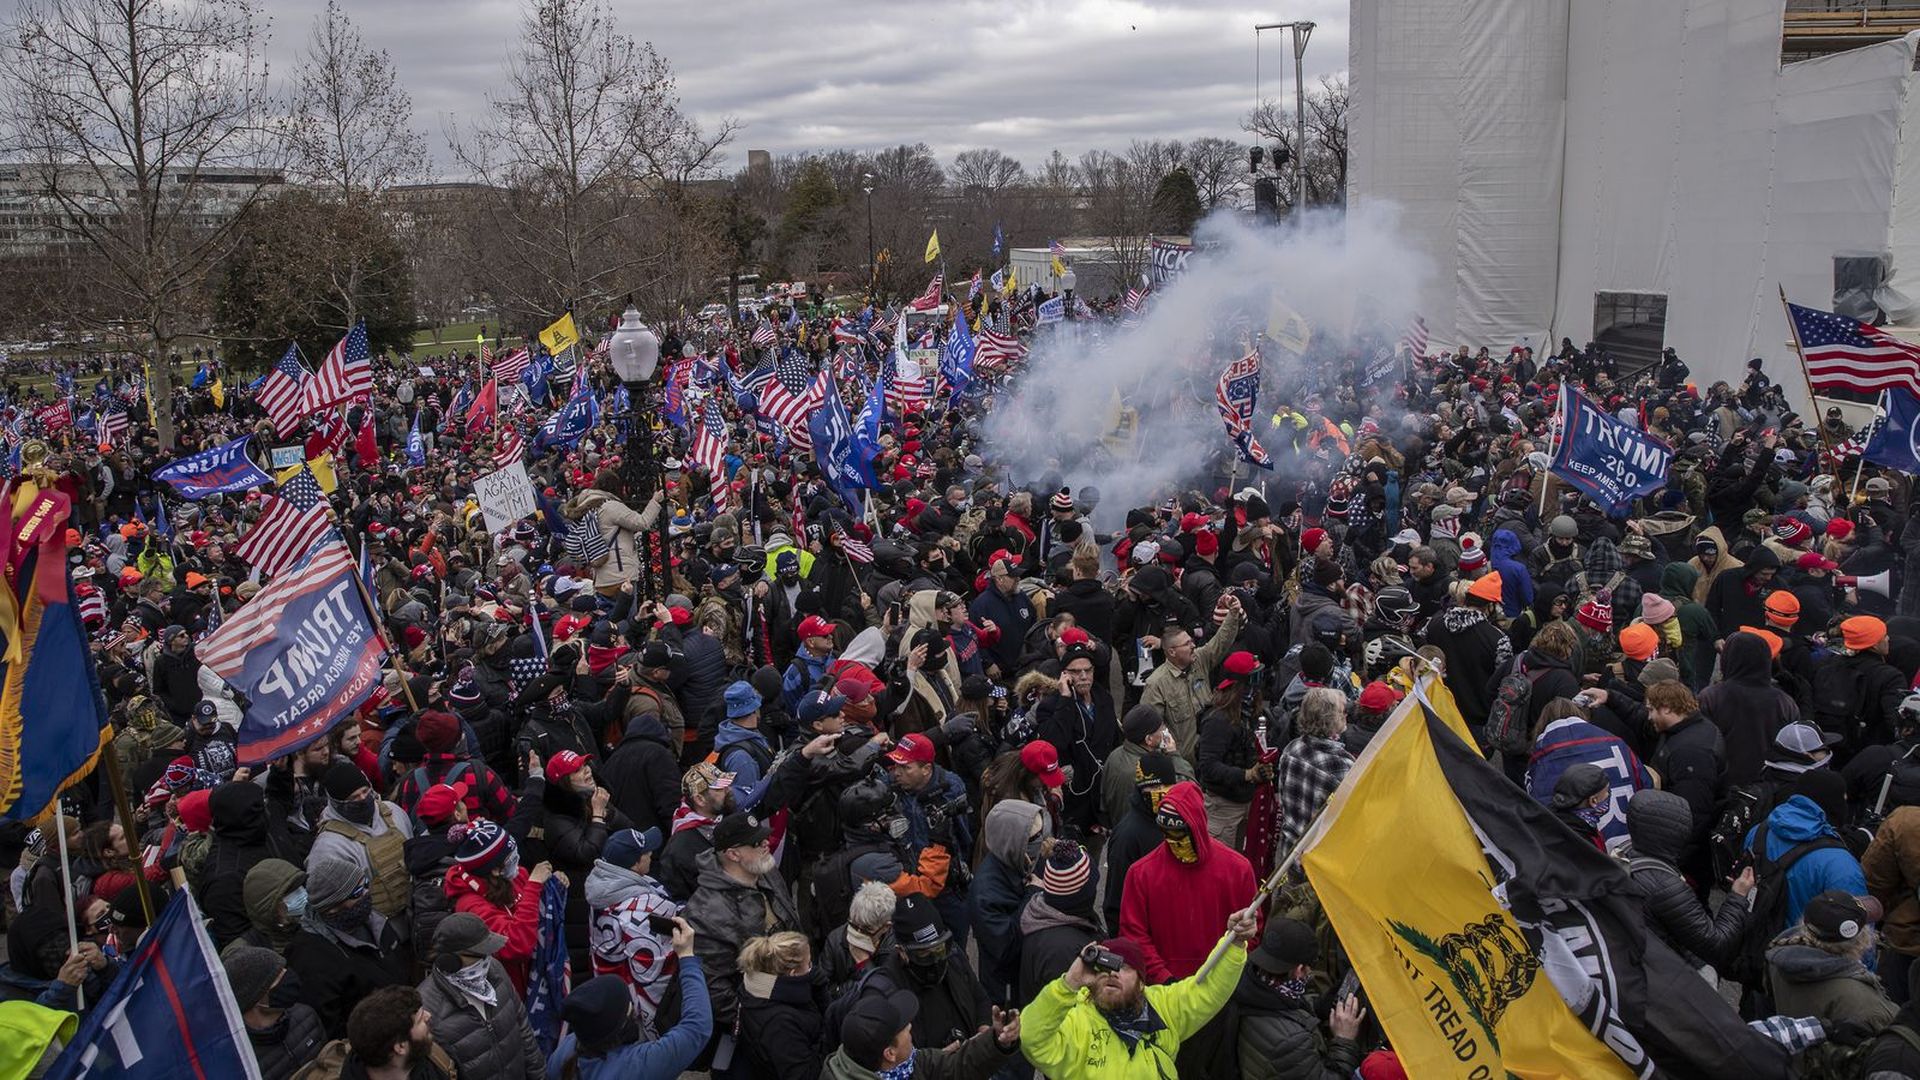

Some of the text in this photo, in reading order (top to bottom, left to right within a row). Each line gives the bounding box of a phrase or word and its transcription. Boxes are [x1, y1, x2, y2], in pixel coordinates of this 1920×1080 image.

[1568, 459, 1596, 476] KEEP
[483, 474, 521, 502] AGAIN
[1424, 980, 1477, 1063] TREAD
[1468, 1064, 1494, 1080] O
